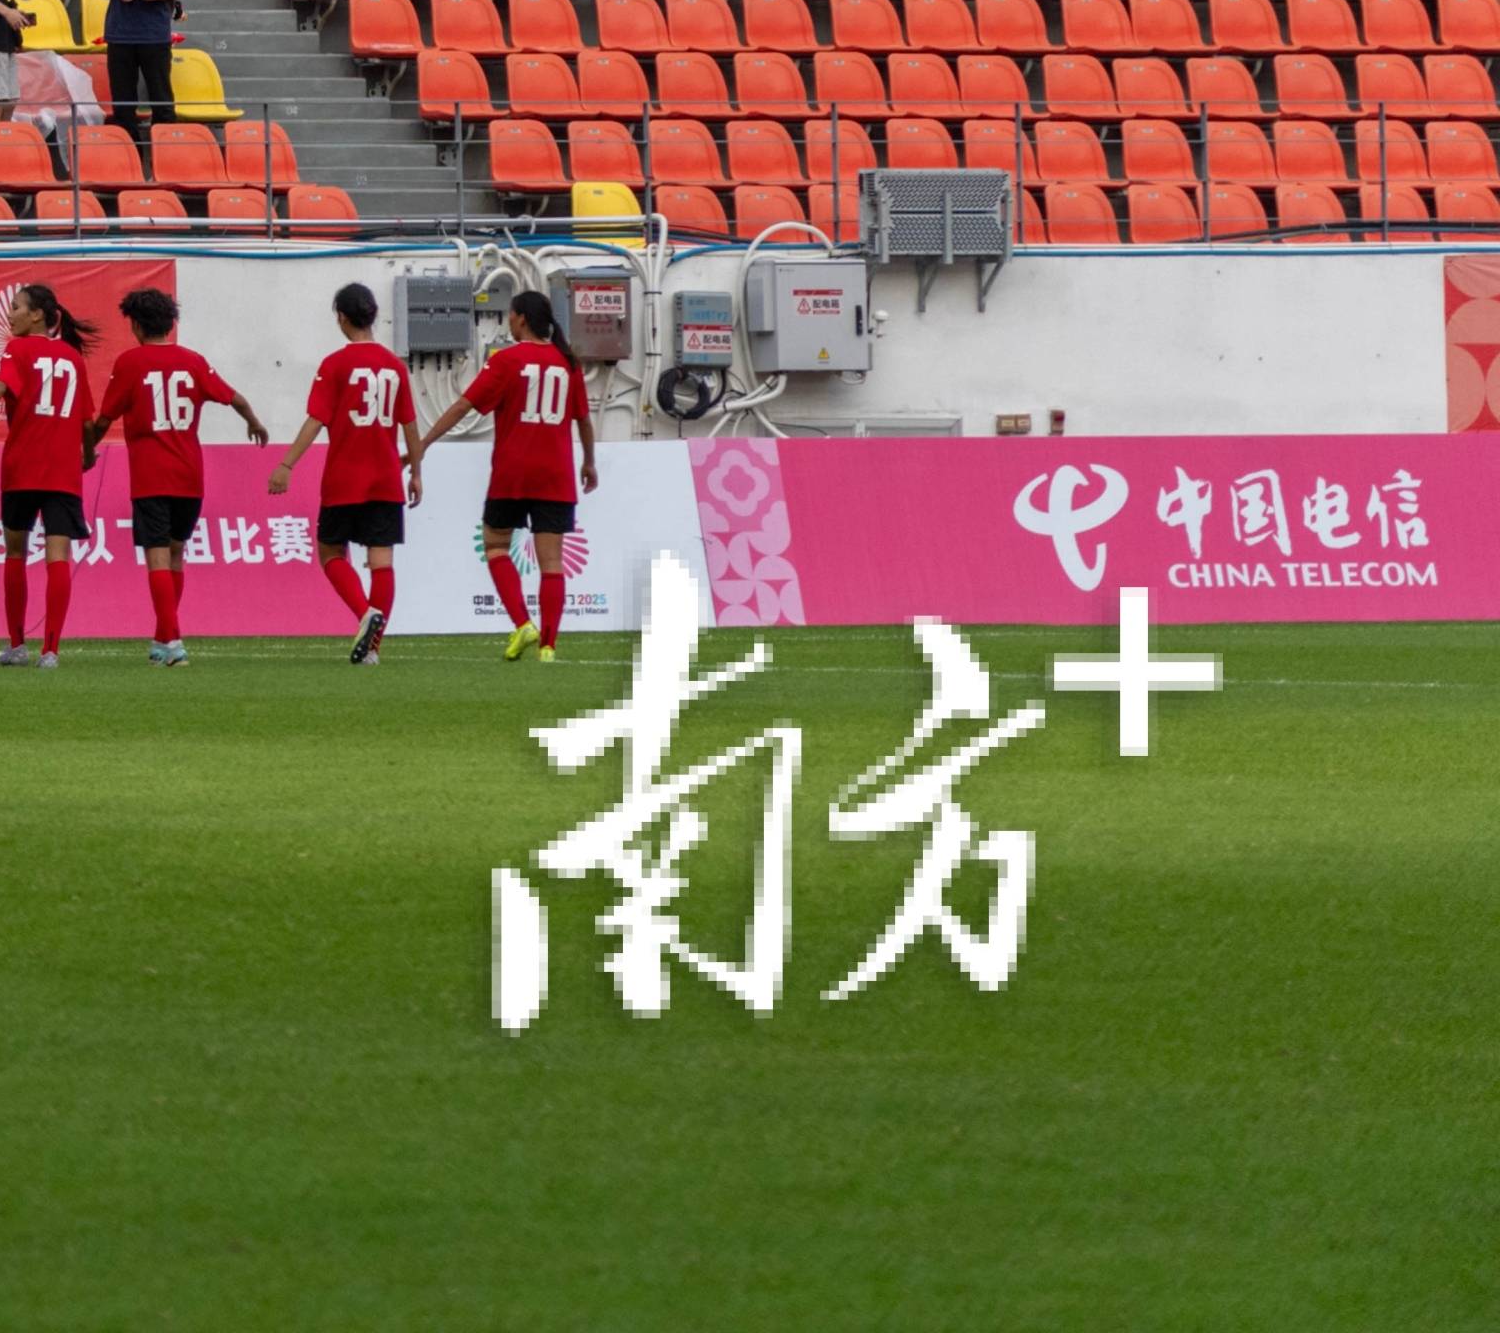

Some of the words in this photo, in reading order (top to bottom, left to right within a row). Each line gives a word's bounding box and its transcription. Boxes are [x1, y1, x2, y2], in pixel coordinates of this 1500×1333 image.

[33, 357, 78, 418] 17
[144, 370, 195, 432] 16
[348, 368, 400, 427] 30
[520, 364, 569, 424] 10
[1155, 466, 1431, 560] 中国电信
[1168, 561, 1274, 589] CHINA
[1281, 560, 1438, 589] TELECOM
